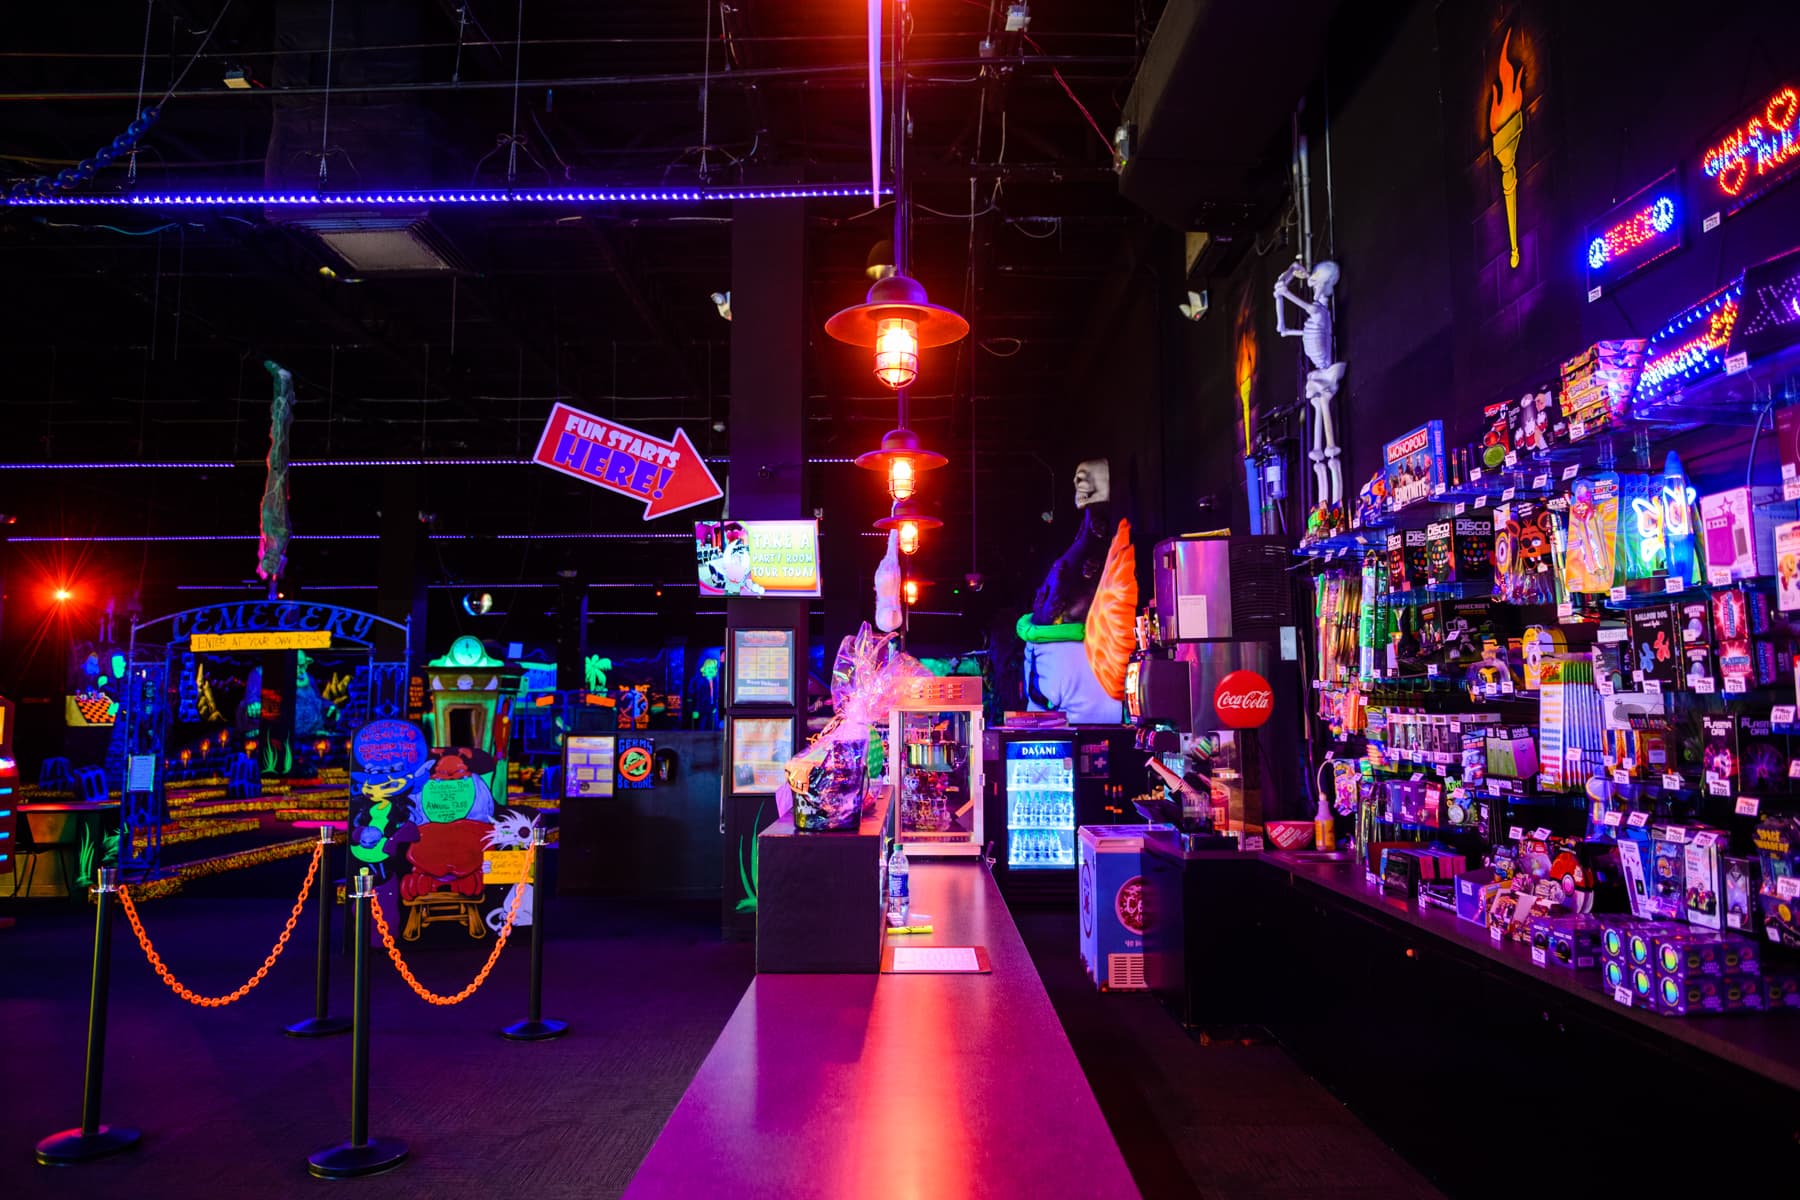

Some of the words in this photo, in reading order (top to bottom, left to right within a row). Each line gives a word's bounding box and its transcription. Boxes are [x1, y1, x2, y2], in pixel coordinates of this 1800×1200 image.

[1703, 117, 1763, 177] GIRLS
[1604, 205, 1656, 262] PEACE
[565, 414, 607, 442] FUN
[607, 430, 681, 468] STARTS
[1389, 429, 1427, 459] MONOPOLY
[553, 431, 675, 499] HERE!
[1428, 523, 1450, 537] DISCO
[1456, 521, 1491, 530] DISCO
[753, 534, 792, 549] TAKE
[800, 534, 811, 549] A
[1388, 534, 1401, 547] DISCO
[752, 553, 781, 563] PARTY
[785, 553, 812, 564] ROOM
[752, 567, 778, 577] TOUR
[782, 567, 815, 577] TODAY
[173, 604, 374, 642] CEMETERY
[198, 636, 226, 650] ENTER
[232, 636, 242, 647] AT
[248, 635, 269, 648] YOUR
[274, 635, 292, 646] OWN
[1217, 690, 1272, 709] Coca-Cola
[1703, 721, 1732, 729] PLASMA
[1741, 720, 1772, 729] PLASM
[1711, 728, 1726, 736] ORB
[1750, 728, 1769, 736] ORB
[618, 738, 653, 754] GERMS
[1022, 745, 1056, 756] DASANI
[617, 773, 630, 789] BE
[1756, 828, 1780, 842] SPACE
[1753, 839, 1790, 853] INVADERS
